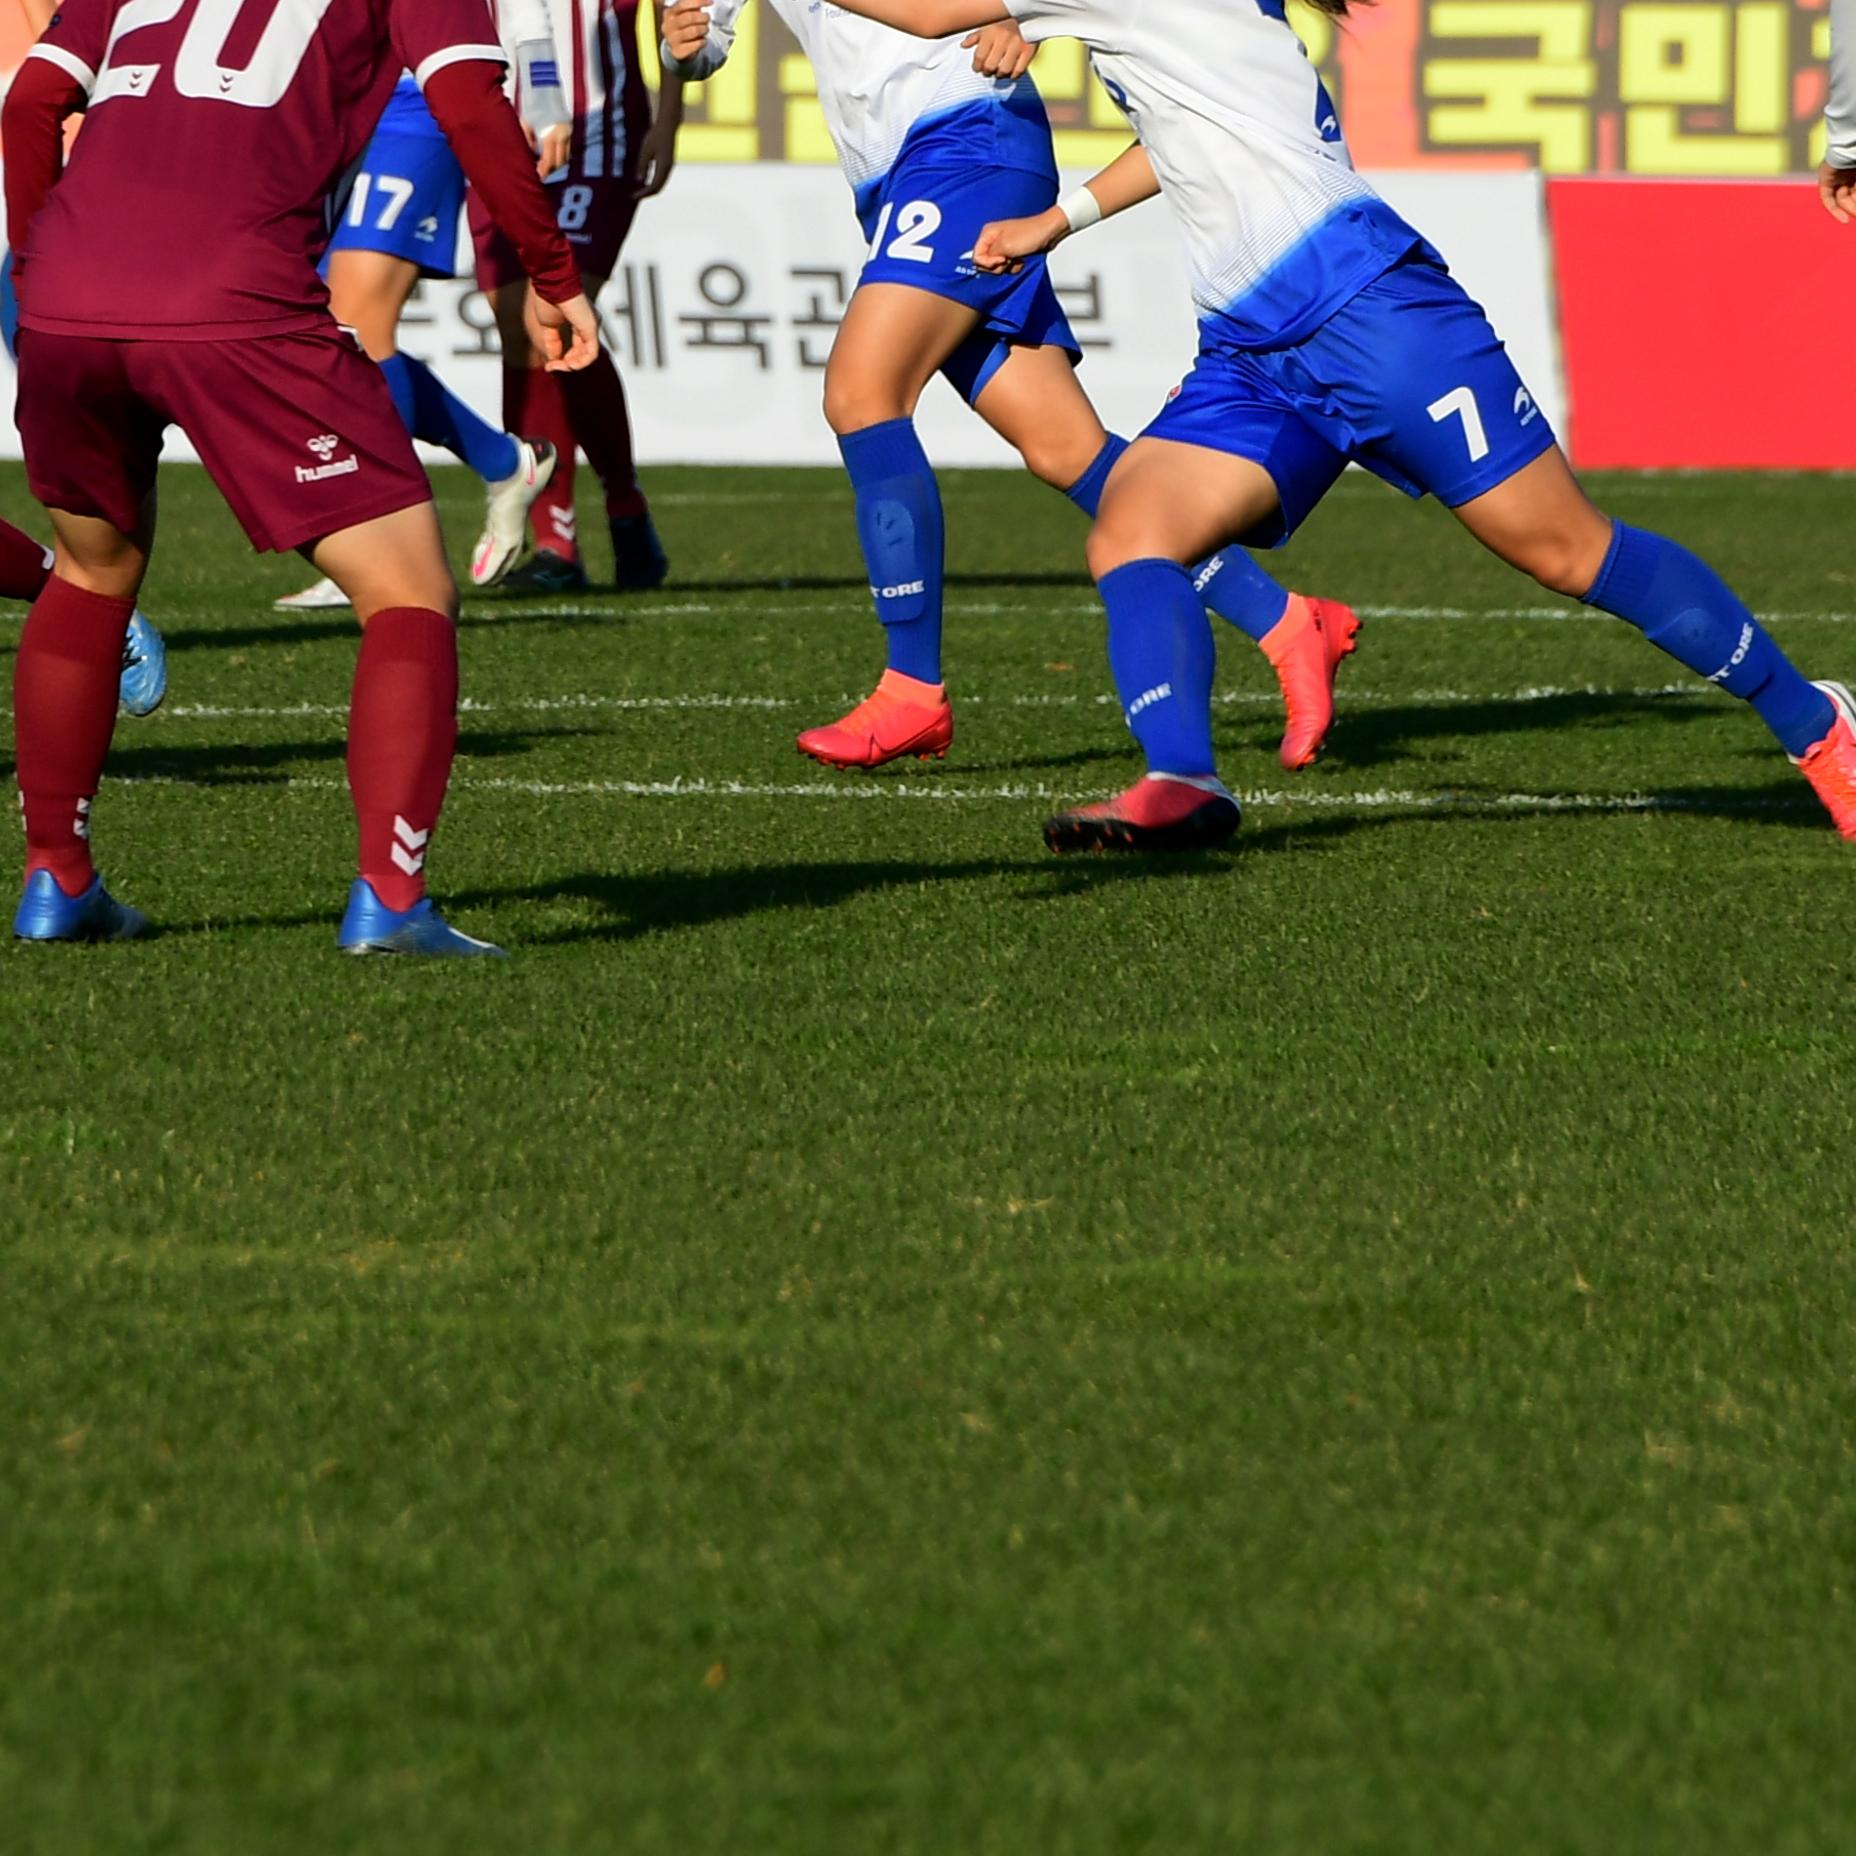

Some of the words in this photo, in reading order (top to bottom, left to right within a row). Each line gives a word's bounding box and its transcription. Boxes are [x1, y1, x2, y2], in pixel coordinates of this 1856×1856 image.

[346, 172, 415, 232] 17
[557, 184, 594, 231] 8
[867, 199, 942, 264] 12
[1425, 385, 1490, 463] 7
